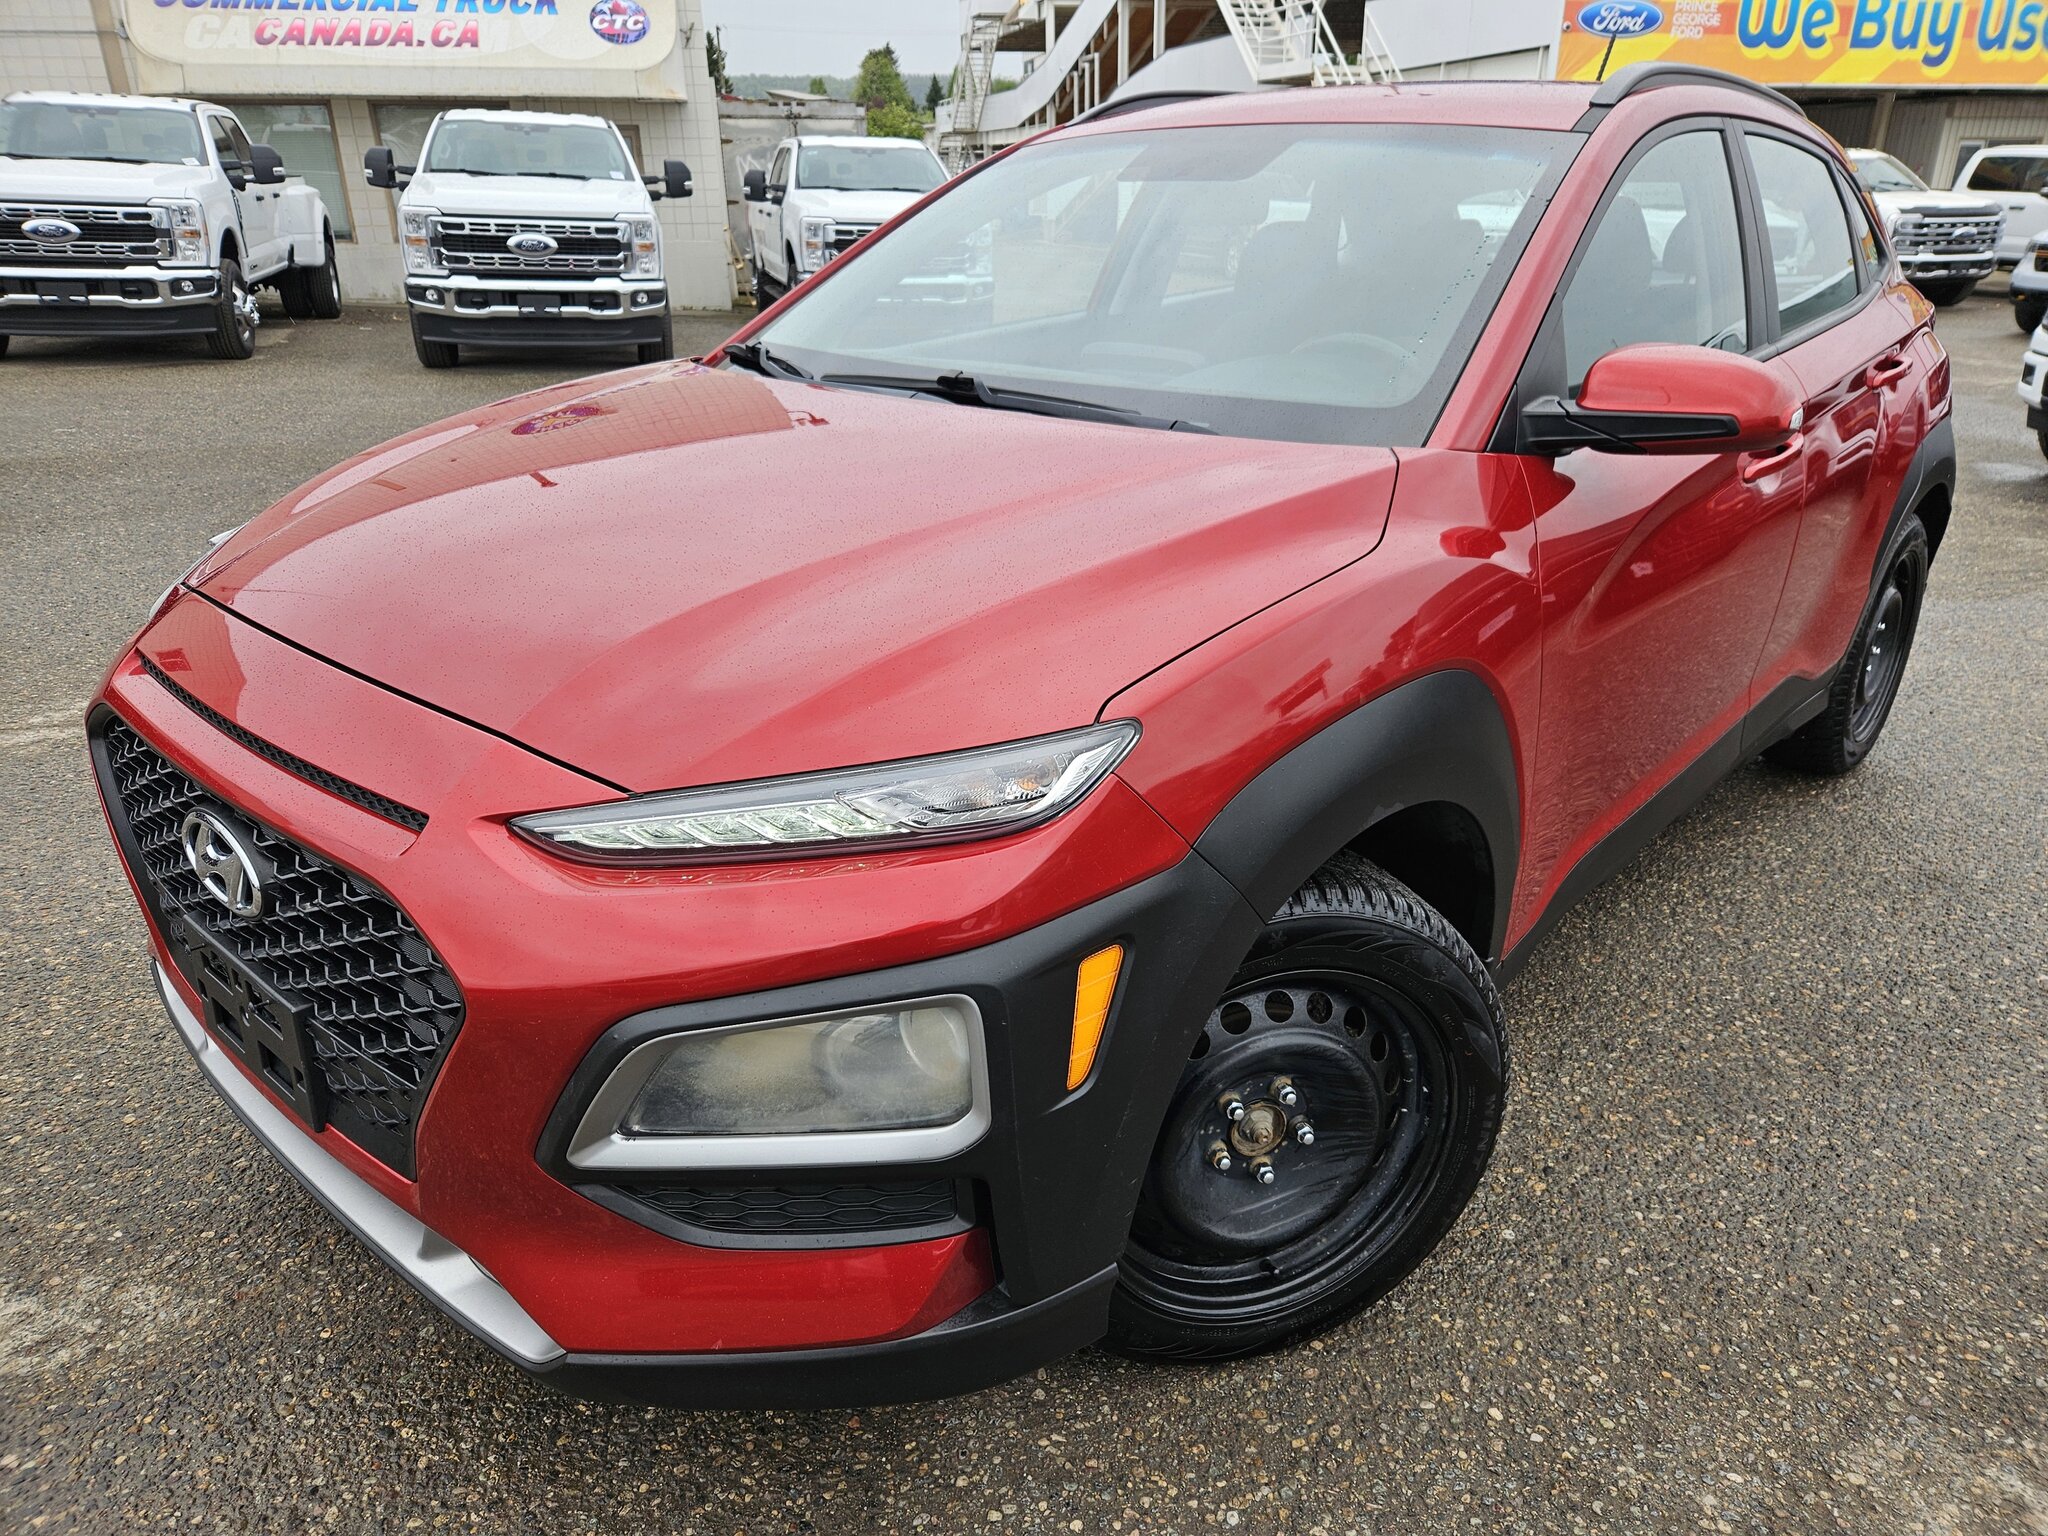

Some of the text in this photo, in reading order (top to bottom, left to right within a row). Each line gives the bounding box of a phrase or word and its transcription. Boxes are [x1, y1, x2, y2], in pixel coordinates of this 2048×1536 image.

[1675, 0, 1719, 12] PRINCE
[592, 13, 646, 31] CTC
[1593, 3, 1648, 33] Ford
[1672, 13, 1722, 26] GEORGE
[254, 17, 480, 48] CANADA.CA
[1670, 26, 1704, 39] FORD
[1737, 0, 2048, 68] We Buy Us
